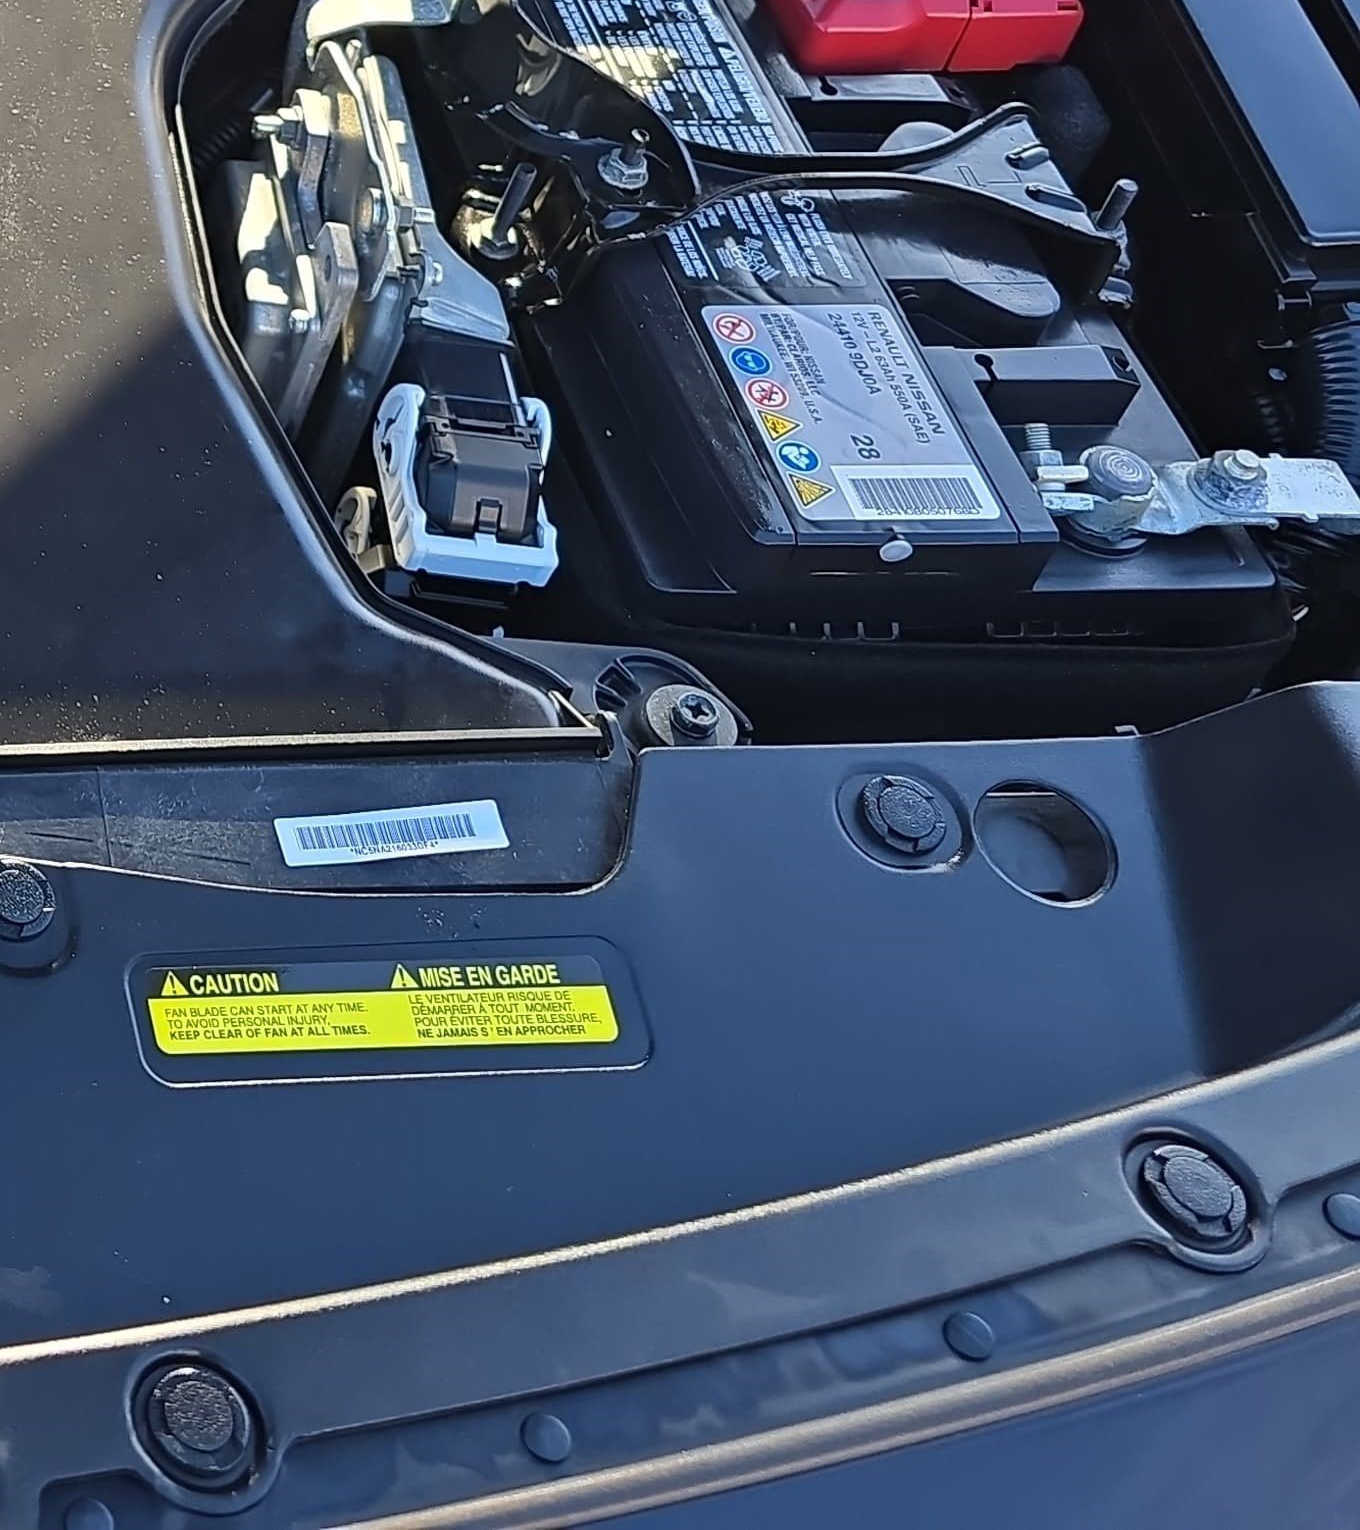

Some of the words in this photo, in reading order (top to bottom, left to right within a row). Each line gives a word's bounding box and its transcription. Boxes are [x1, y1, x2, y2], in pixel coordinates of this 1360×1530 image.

[827, 312, 858, 350] 24410
[851, 311, 869, 331] 12V
[874, 355, 896, 383] 63Ah
[889, 384, 913, 413] 550A
[903, 411, 931, 445] (SAE)
[868, 311, 910, 369] RENAULT
[901, 372, 946, 436] NISSAN
[849, 434, 882, 461] 28
[189, 972, 280, 995] CAUTION
[418, 966, 466, 988] MISE
[467, 965, 493, 986] EN
[495, 964, 561, 986] GARDE
[408, 994, 425, 1006] LE
[425, 991, 508, 1005] VENTILATEUR
[510, 991, 553, 1003] RISQUE
[555, 990, 571, 1001] DE
[165, 1007, 187, 1019] FAN
[190, 1006, 227, 1018] BLADE
[230, 1005, 254, 1017] CAN
[257, 1004, 293, 1016] START
[295, 1004, 312, 1014] AT
[313, 1003, 334, 1014] ANY
[336, 1002, 369, 1013] TIME.
[411, 1002, 478, 1016] DÉMARRER
[479, 1001, 489, 1014] À
[488, 1003, 520, 1015] TOUT
[525, 1001, 576, 1014] MOMENT.
[168, 1019, 183, 1030] TO
[185, 1018, 220, 1029] AVOID
[223, 1016, 286, 1028] PERSONAL
[287, 1015, 331, 1027] INJURY,
[414, 1016, 448, 1028] POUR
[449, 1013, 492, 1026] ÉVITER
[493, 1014, 536, 1026] TOUTE
[536, 1012, 603, 1025] BLESSURE,
[170, 1030, 201, 1041] KEEP
[203, 1029, 243, 1040] CLEAR
[246, 1028, 262, 1039] OF
[265, 1027, 288, 1038] FAN
[290, 1026, 306, 1037] AT
[307, 1026, 330, 1037] ALL
[331, 1024, 372, 1036] TIMES.
[417, 1028, 434, 1039] NE
[436, 1026, 479, 1038] JAMAIS
[496, 1026, 513, 1037] EN
[515, 1024, 587, 1036] APPROCHER
